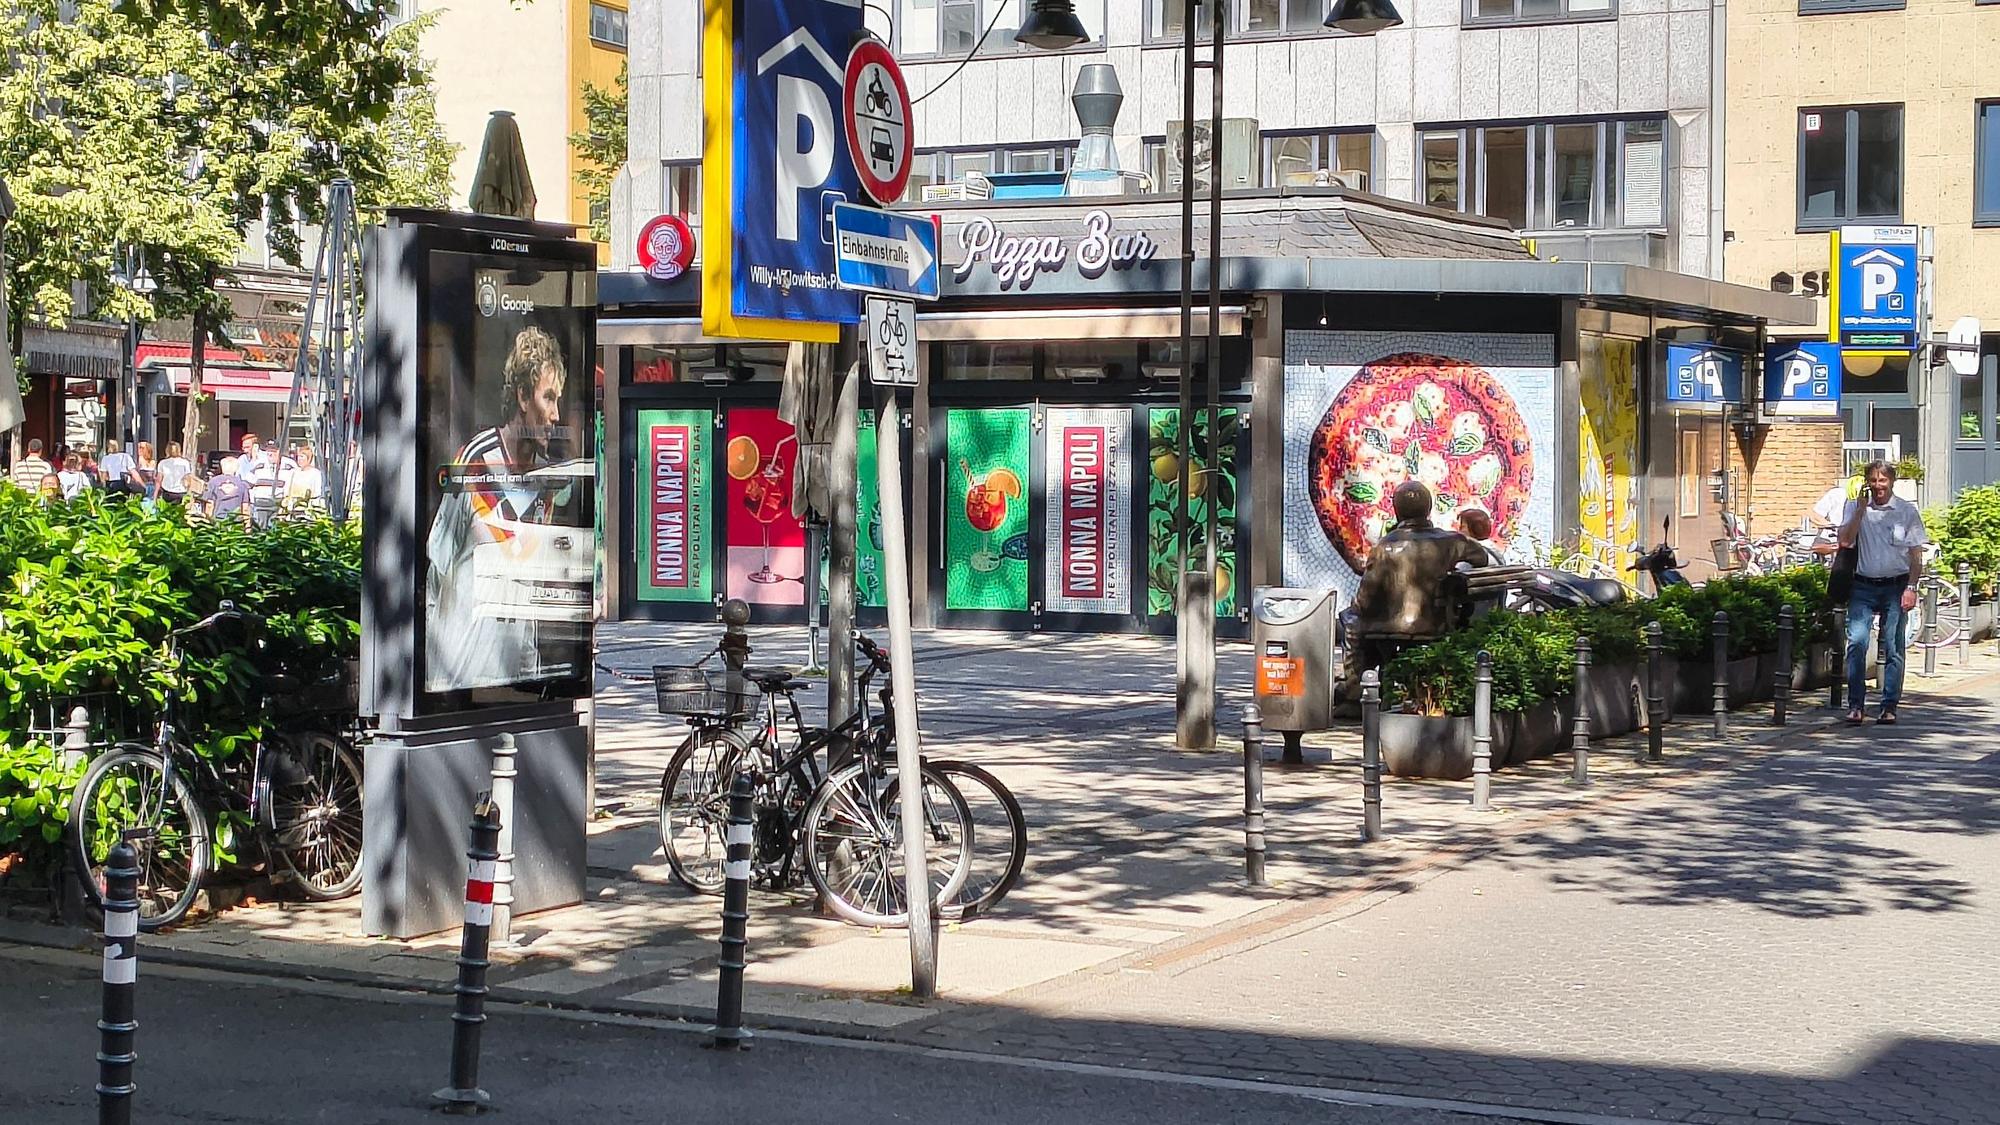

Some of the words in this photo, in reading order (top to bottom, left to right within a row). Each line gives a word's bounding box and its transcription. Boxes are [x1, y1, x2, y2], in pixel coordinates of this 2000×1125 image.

[776, 74, 835, 242] P
[842, 236, 909, 264] Einbahnstraße
[953, 215, 1067, 284] Pizza
[1076, 209, 1157, 272] Bar
[501, 293, 534, 315] Google
[1862, 262, 1897, 310] P
[1783, 360, 1812, 397] P
[692, 425, 701, 451] BAR
[1108, 425, 1117, 453] BAR
[656, 432, 684, 504] NAPOLI
[692, 457, 701, 497] PIZZA
[1070, 432, 1098, 508] NAPOLI
[1108, 458, 1117, 502] PIZZA
[656, 511, 683, 580] NONNA
[691, 503, 700, 588] NEAPOLITAN
[1069, 516, 1097, 592] NONNA
[1107, 508, 1117, 599] NEAPOLITAN
